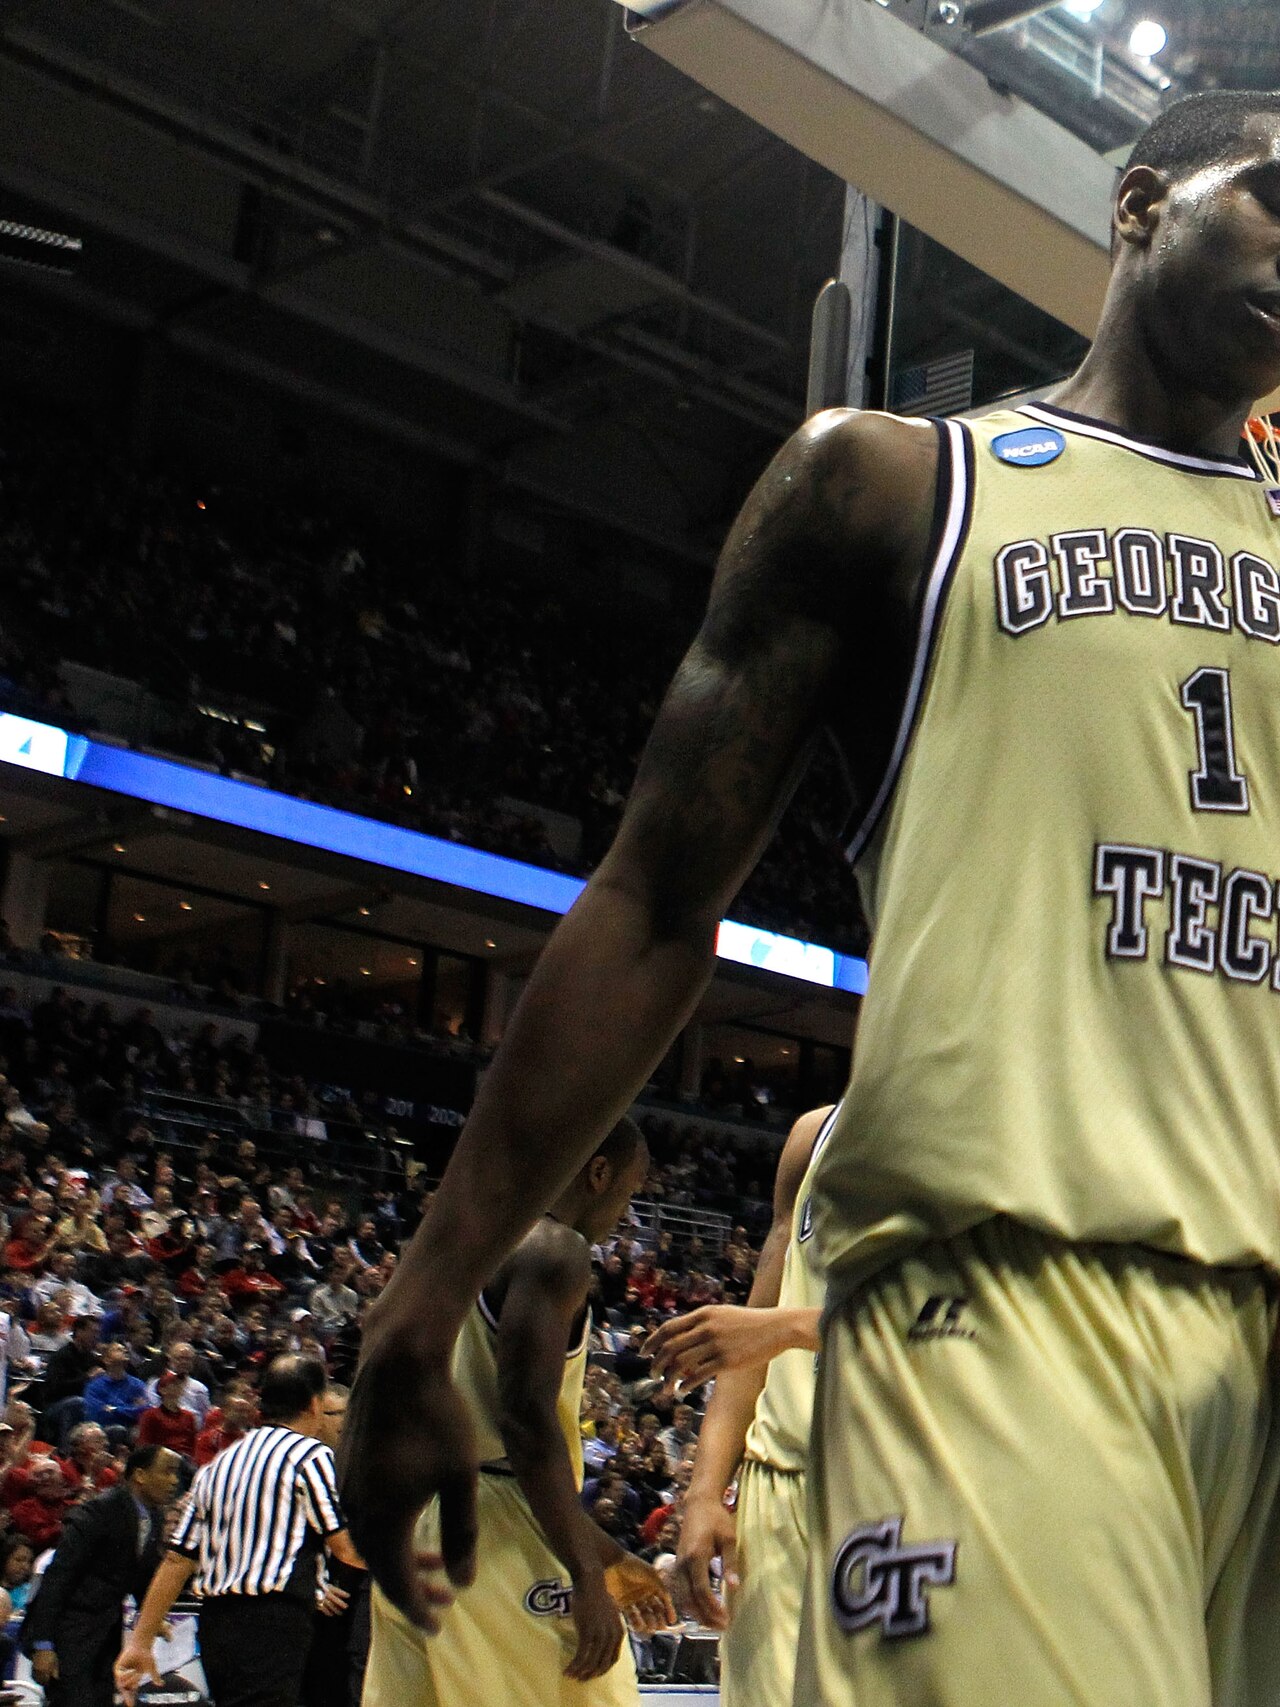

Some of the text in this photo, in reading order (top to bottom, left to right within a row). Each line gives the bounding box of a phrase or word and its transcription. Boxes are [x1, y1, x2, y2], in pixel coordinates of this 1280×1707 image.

[1002, 441, 1058, 458] NCAA
[1180, 666, 1250, 815] 1
[833, 1516, 957, 1637] GT
